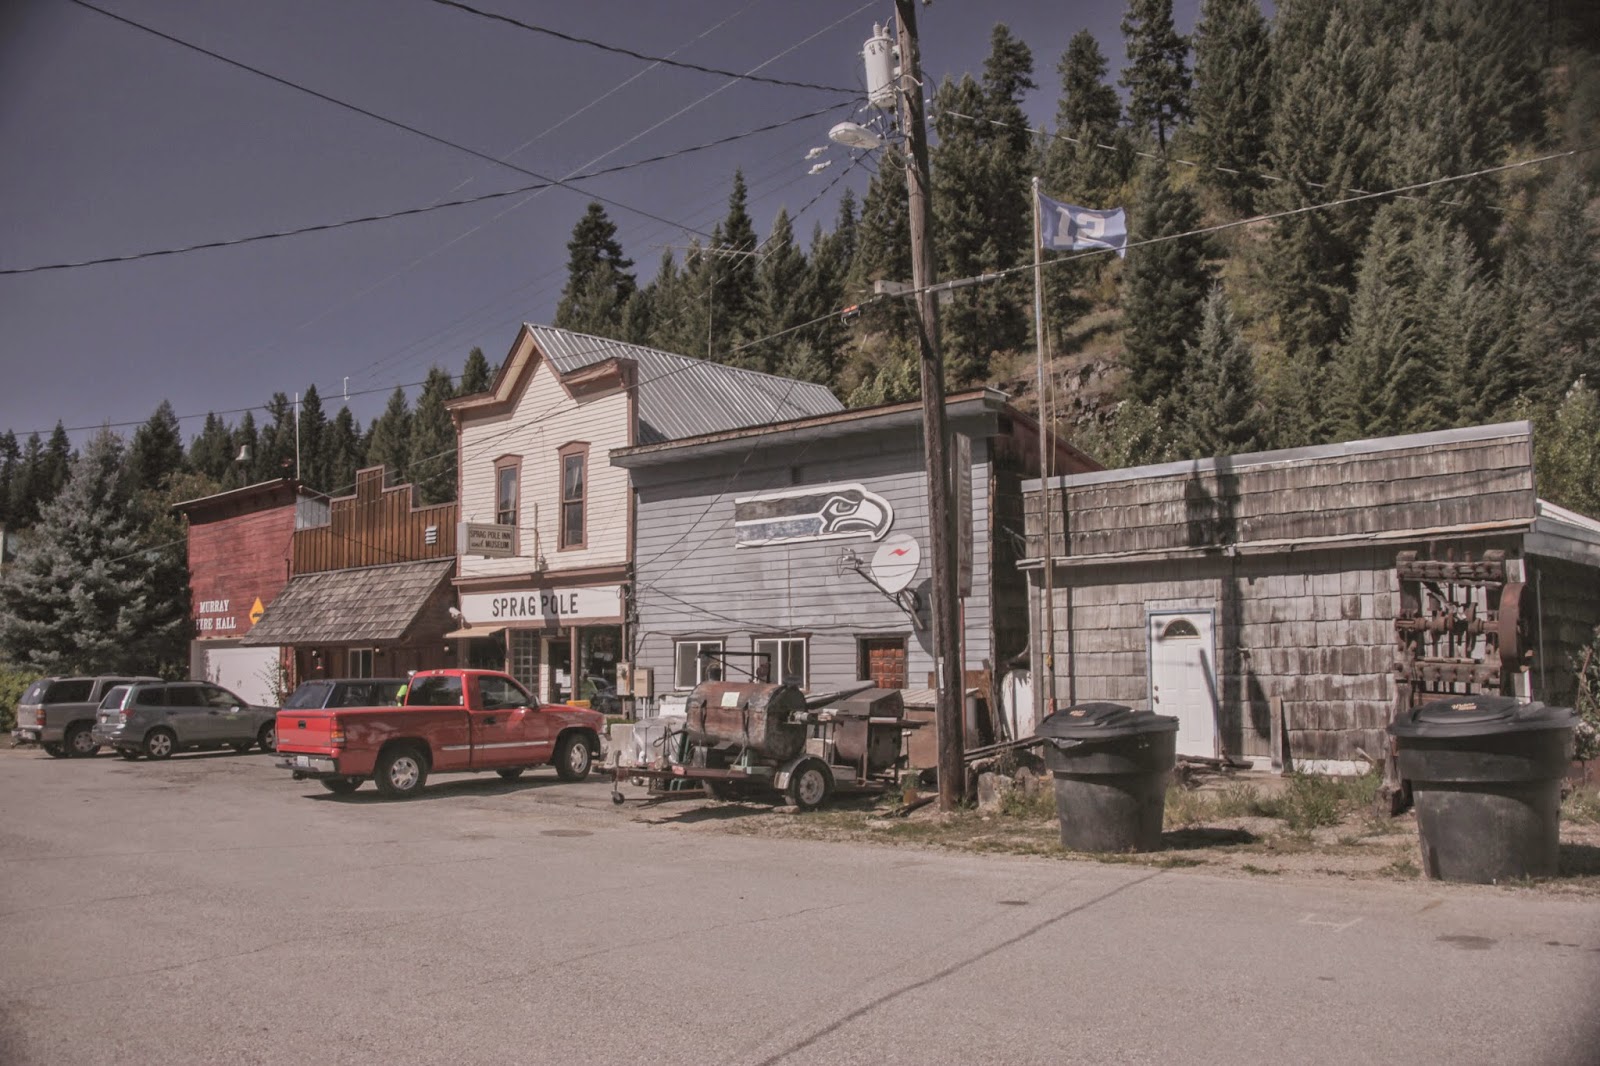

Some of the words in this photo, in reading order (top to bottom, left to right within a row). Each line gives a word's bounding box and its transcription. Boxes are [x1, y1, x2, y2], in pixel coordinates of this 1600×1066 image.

[470, 530, 487, 539] SPRAG
[488, 531, 500, 539] POLE
[502, 532, 511, 540] INN
[485, 540, 509, 549] MUSEUM
[199, 599, 229, 613] MURRAY
[492, 596, 536, 617] SPRAG
[541, 593, 578, 615] POLE
[196, 618, 213, 630] FIRE
[216, 617, 236, 630] HALL
